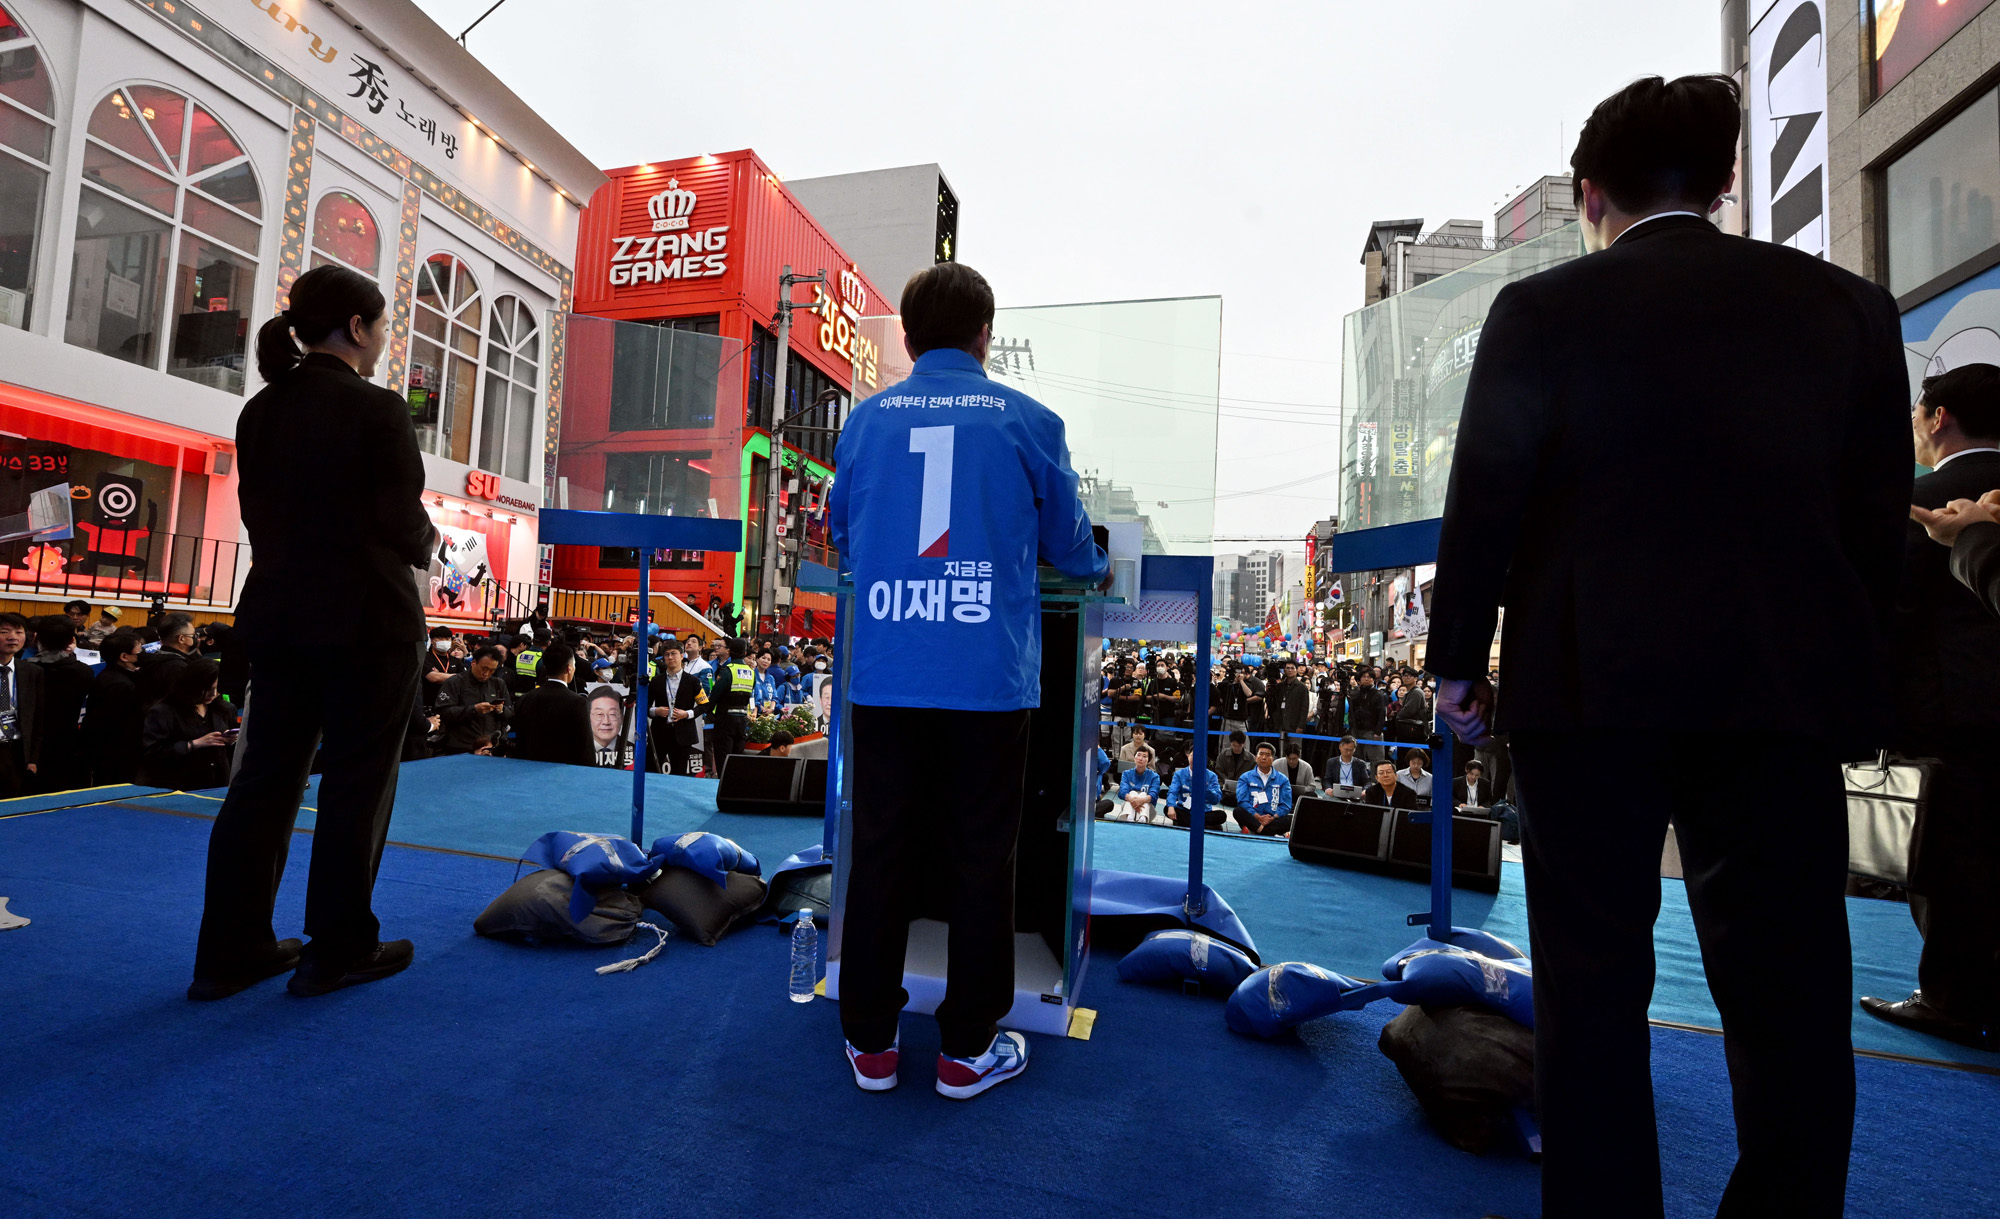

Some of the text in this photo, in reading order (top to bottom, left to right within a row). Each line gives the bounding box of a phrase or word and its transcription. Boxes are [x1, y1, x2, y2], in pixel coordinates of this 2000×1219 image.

[347, 53, 389, 114] 秀
[396, 98, 459, 160] 노래방
[610, 226, 730, 262] ZZANG
[609, 253, 728, 286] GAMES
[880, 394, 1006, 411] 이제부터 진짜 대한민국
[1393, 423, 1410, 475] 방탈출
[466, 470, 501, 500] SU
[909, 424, 955, 558] 1
[496, 495, 535, 512] NORAEBANG
[944, 561, 993, 578] 지금은
[868, 579, 992, 624] 이재명
